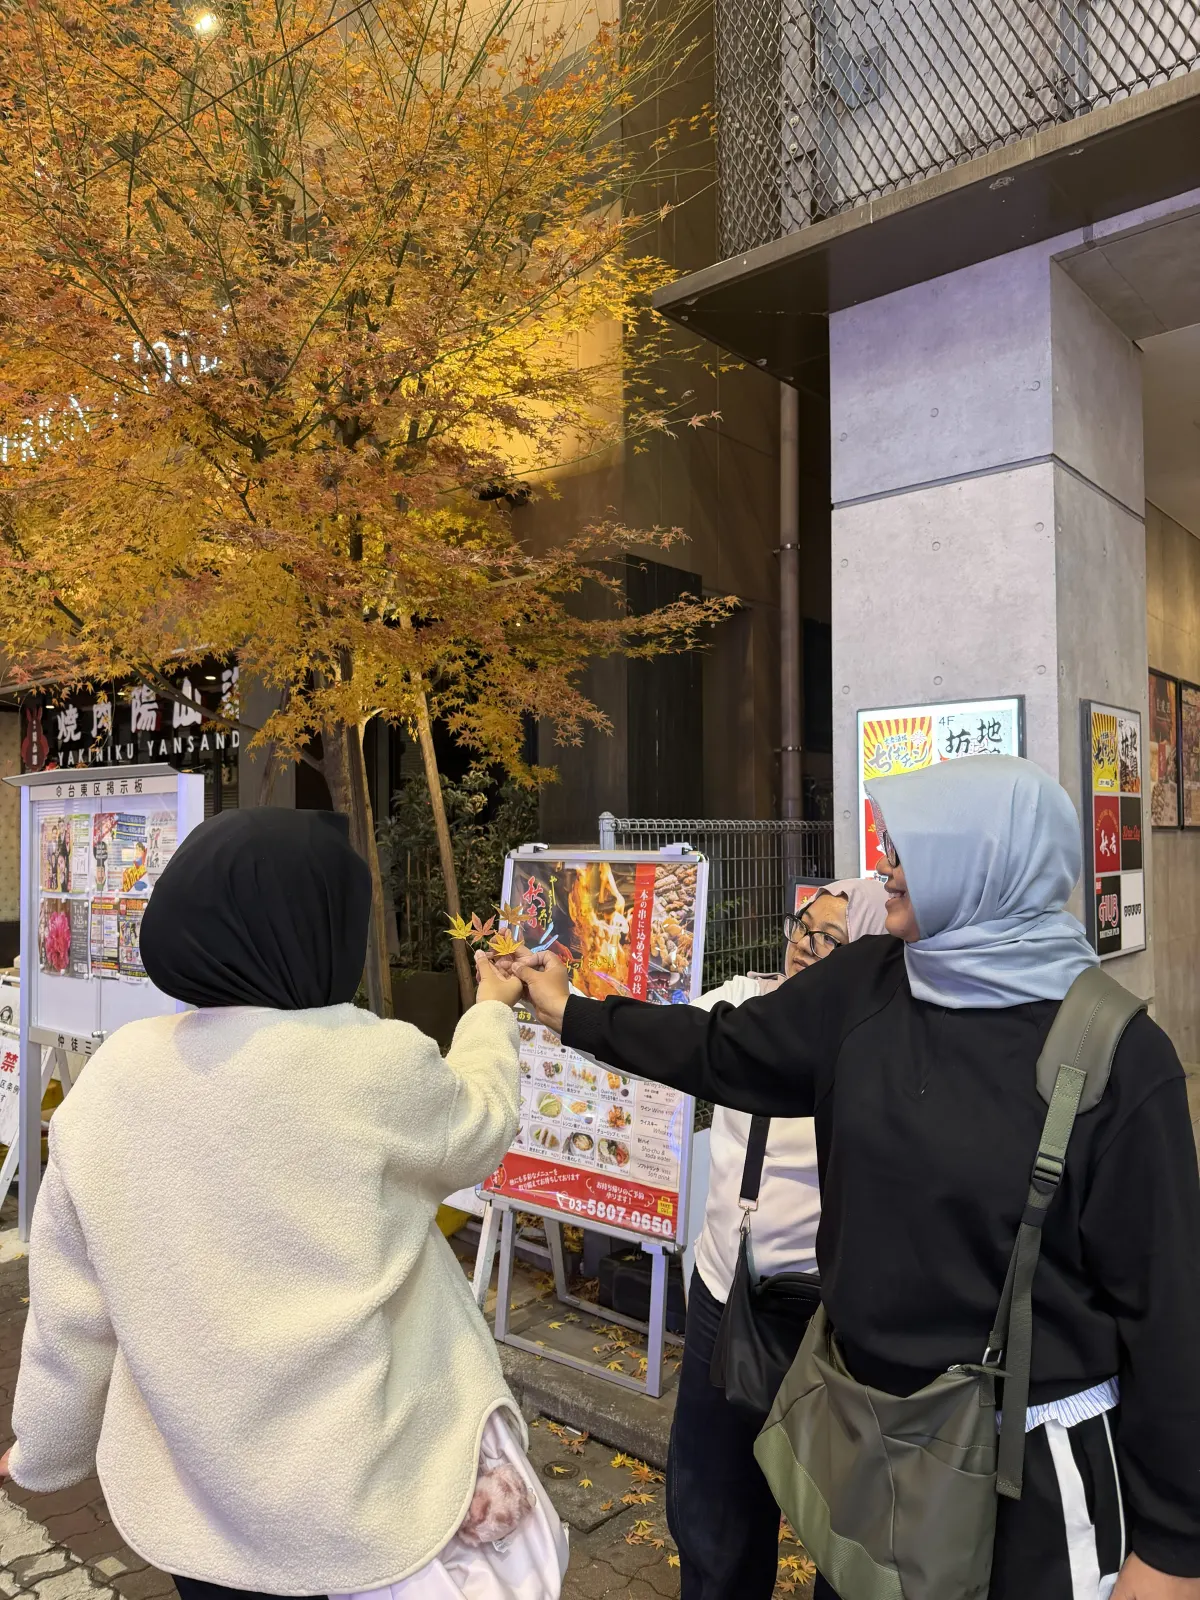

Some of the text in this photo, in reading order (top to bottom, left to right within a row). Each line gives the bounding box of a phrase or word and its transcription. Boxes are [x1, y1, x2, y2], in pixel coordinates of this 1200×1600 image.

[938, 715, 955, 726] 4F
[58, 743, 134, 766] YAKINIKU
[68, 778, 143, 797] 台東区掲示板
[1098, 893, 1119, 928] HUB
[632, 881, 650, 994] 一本の串に込める匠の技
[596, 1181, 645, 1200] お持ち帰りのご予約
[568, 1197, 673, 1236] 03-5807-0650
